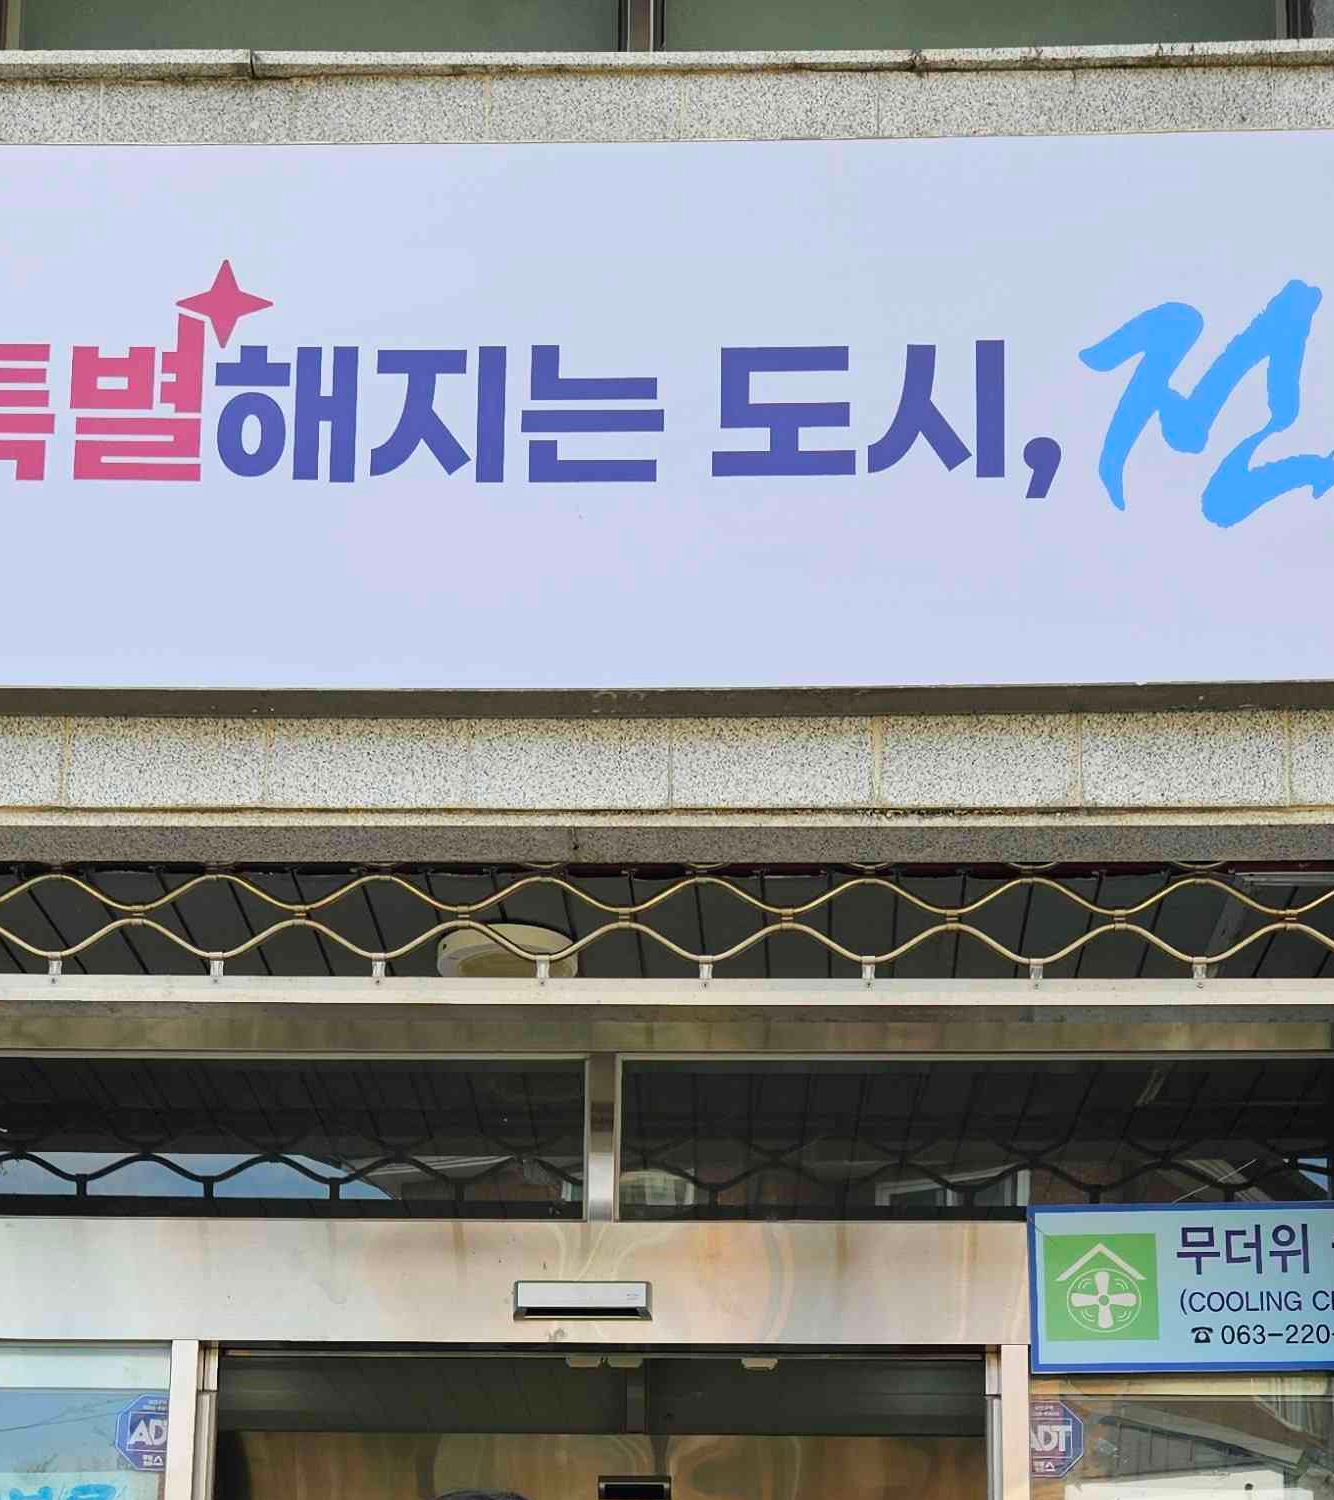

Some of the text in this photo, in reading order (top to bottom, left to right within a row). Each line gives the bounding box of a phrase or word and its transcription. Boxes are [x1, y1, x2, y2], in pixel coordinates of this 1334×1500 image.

[711, 339, 1063, 499] 도시,
[1176, 1223, 1310, 1276] 무더위
[1180, 1287, 1302, 1315] (COOLING
[128, 1419, 168, 1446] AD
